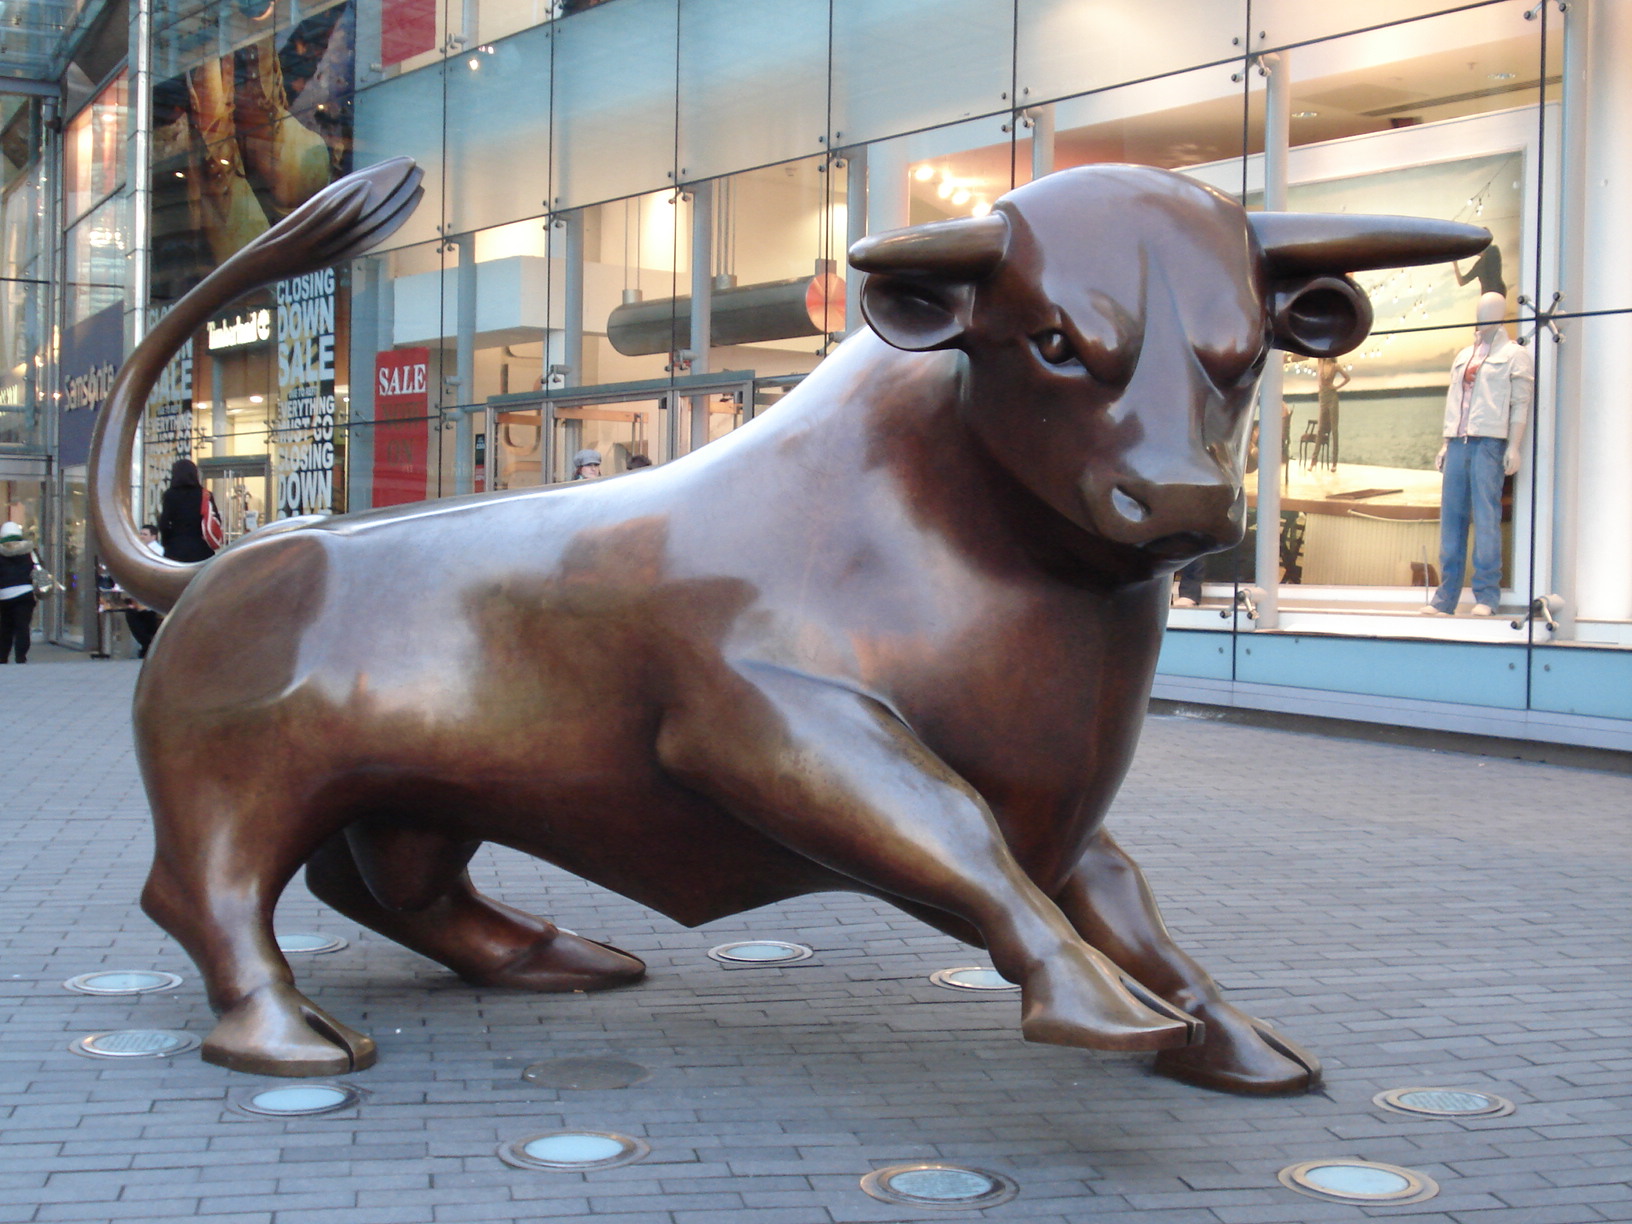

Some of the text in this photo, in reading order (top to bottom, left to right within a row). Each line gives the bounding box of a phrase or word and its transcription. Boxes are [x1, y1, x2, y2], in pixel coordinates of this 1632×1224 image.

[277, 267, 335, 304] CLOSING
[277, 295, 335, 342] DOWN
[278, 335, 335, 388] SALE
[378, 364, 427, 396] SALE
[277, 396, 335, 420] EVERYTHING
[380, 401, 425, 431] NOW
[277, 415, 334, 443] MUST GO
[277, 442, 334, 472] CLOSING
[386, 438, 415, 466] ON
[277, 470, 333, 511] DOWN
